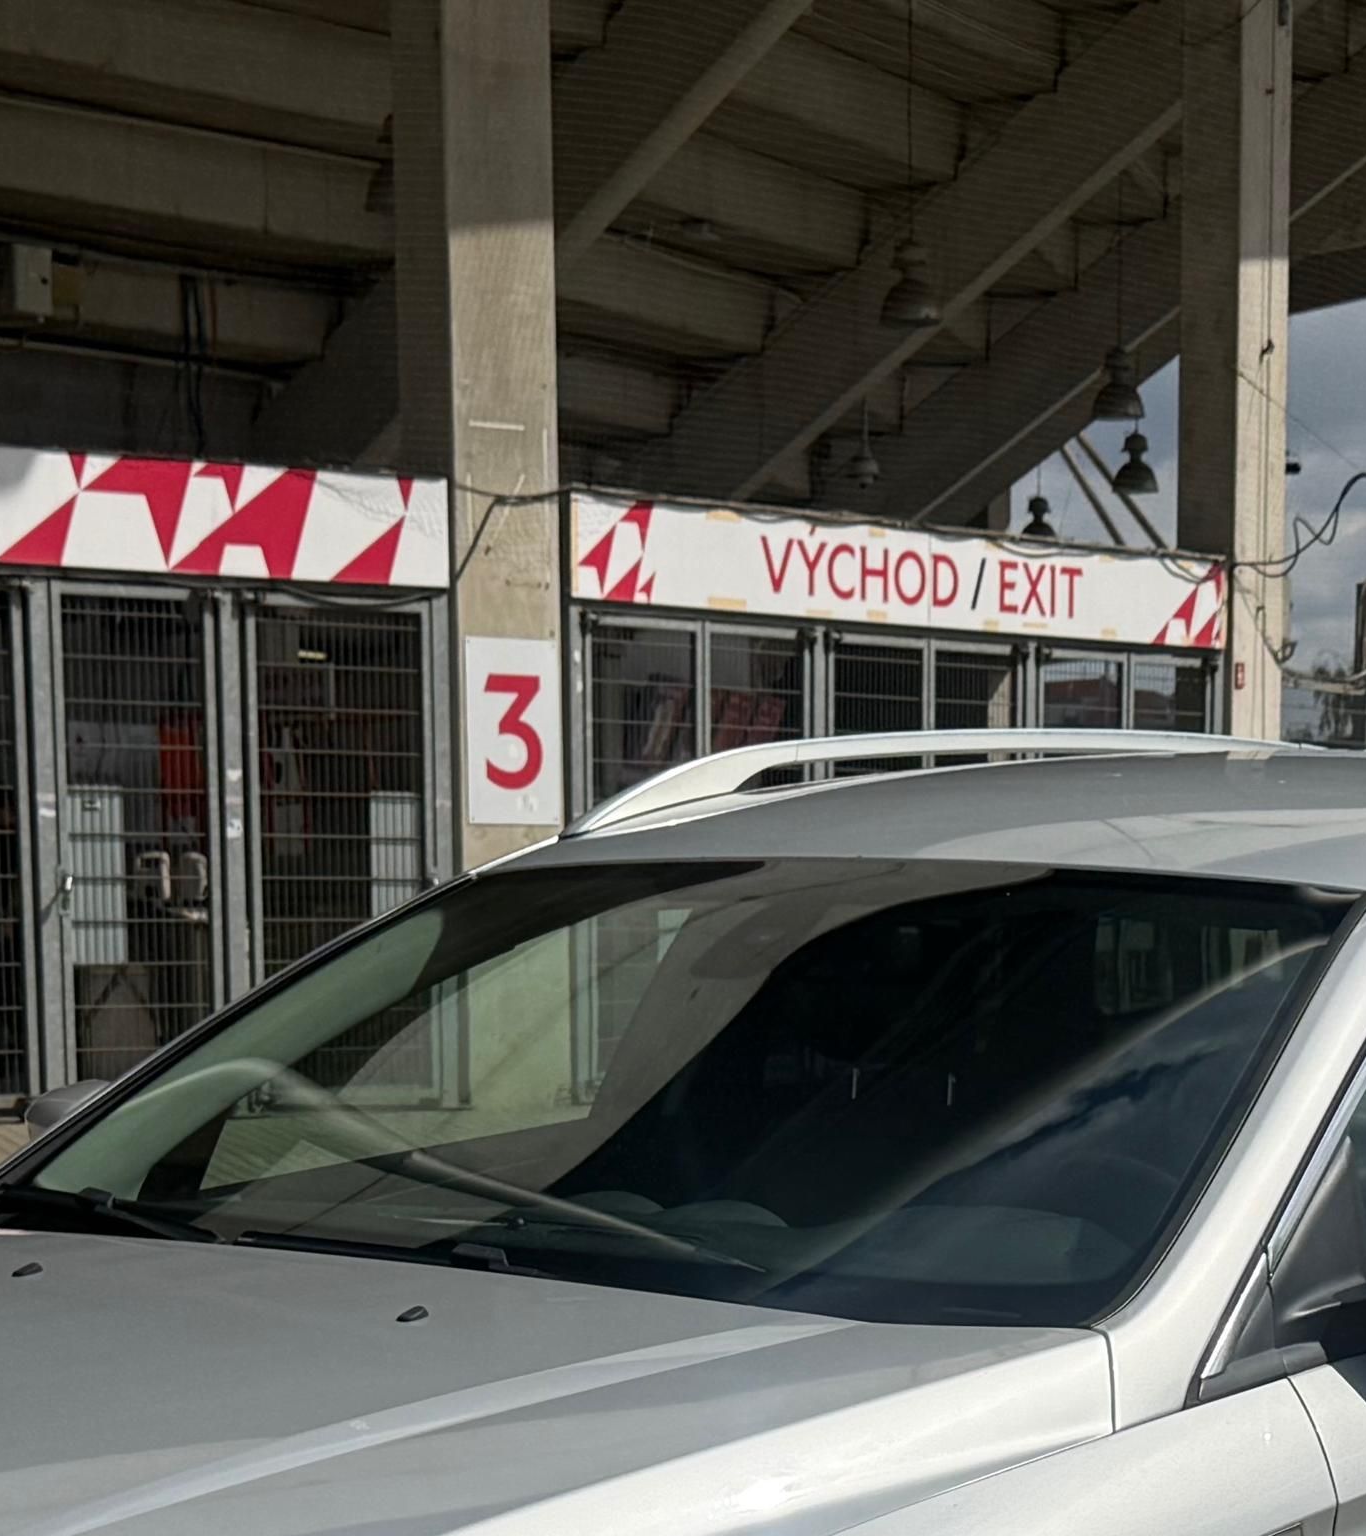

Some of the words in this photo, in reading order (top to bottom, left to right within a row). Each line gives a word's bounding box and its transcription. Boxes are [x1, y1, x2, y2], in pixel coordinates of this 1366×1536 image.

[761, 525, 960, 608] VÝCHOD
[970, 557, 986, 612] /
[998, 559, 1084, 620] EXIT
[484, 673, 544, 790] 3
